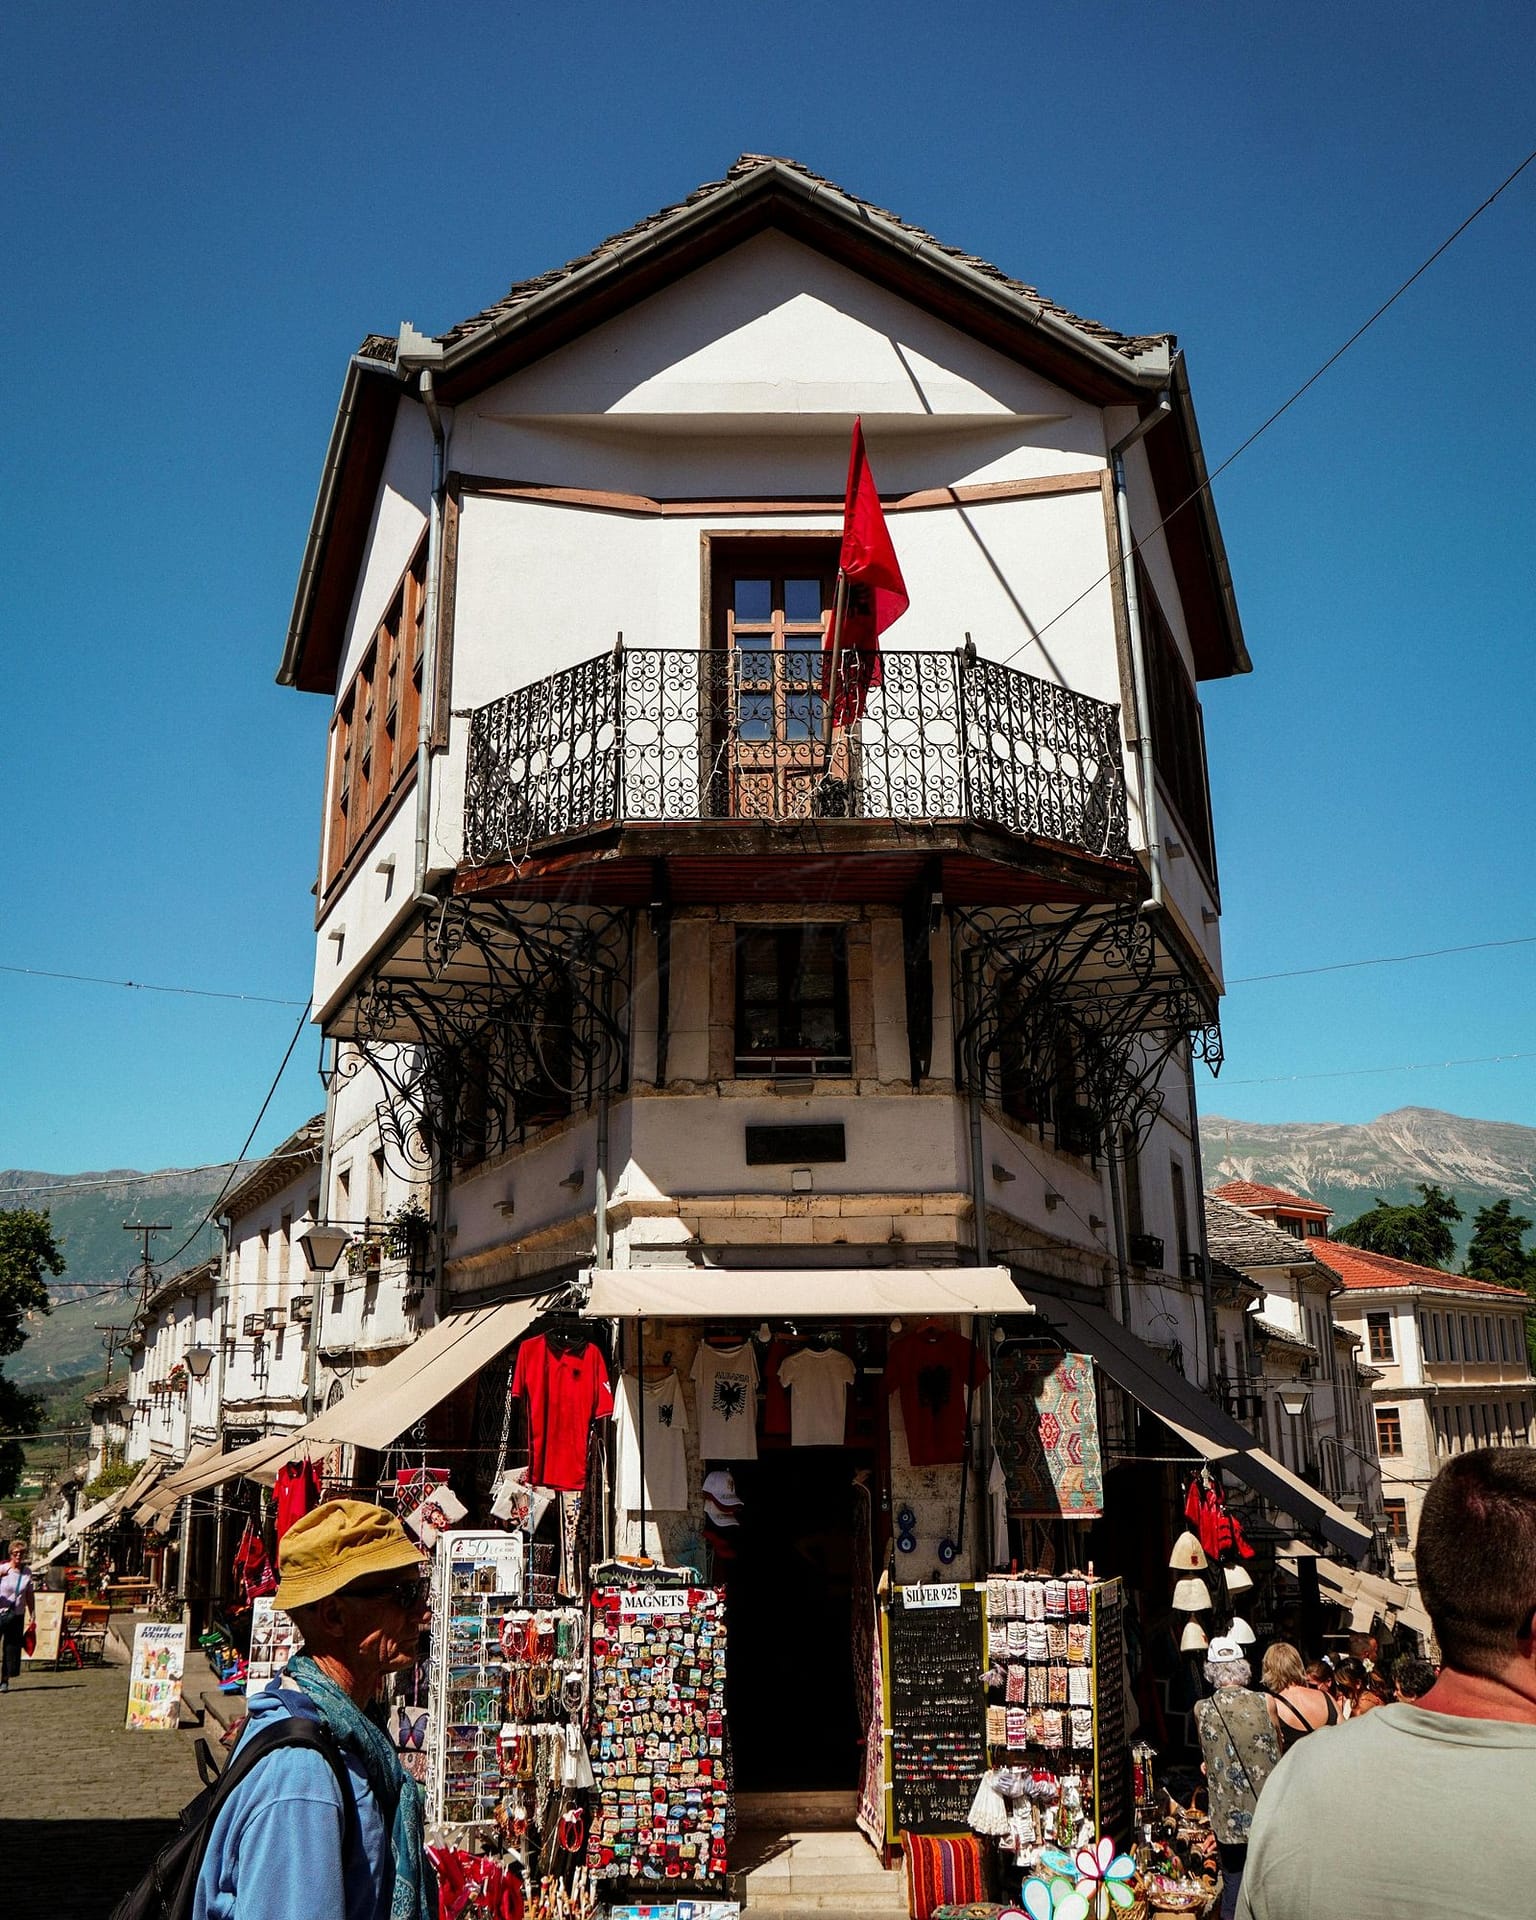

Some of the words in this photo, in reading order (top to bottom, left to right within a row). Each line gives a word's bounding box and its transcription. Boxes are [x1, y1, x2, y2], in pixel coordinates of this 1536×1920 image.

[467, 1540, 489, 1556] 50
[624, 1595, 685, 1608] MAGNETS
[906, 1589, 940, 1602] SILVER
[941, 1587, 958, 1601] 925
[141, 1631, 184, 1639] Market
